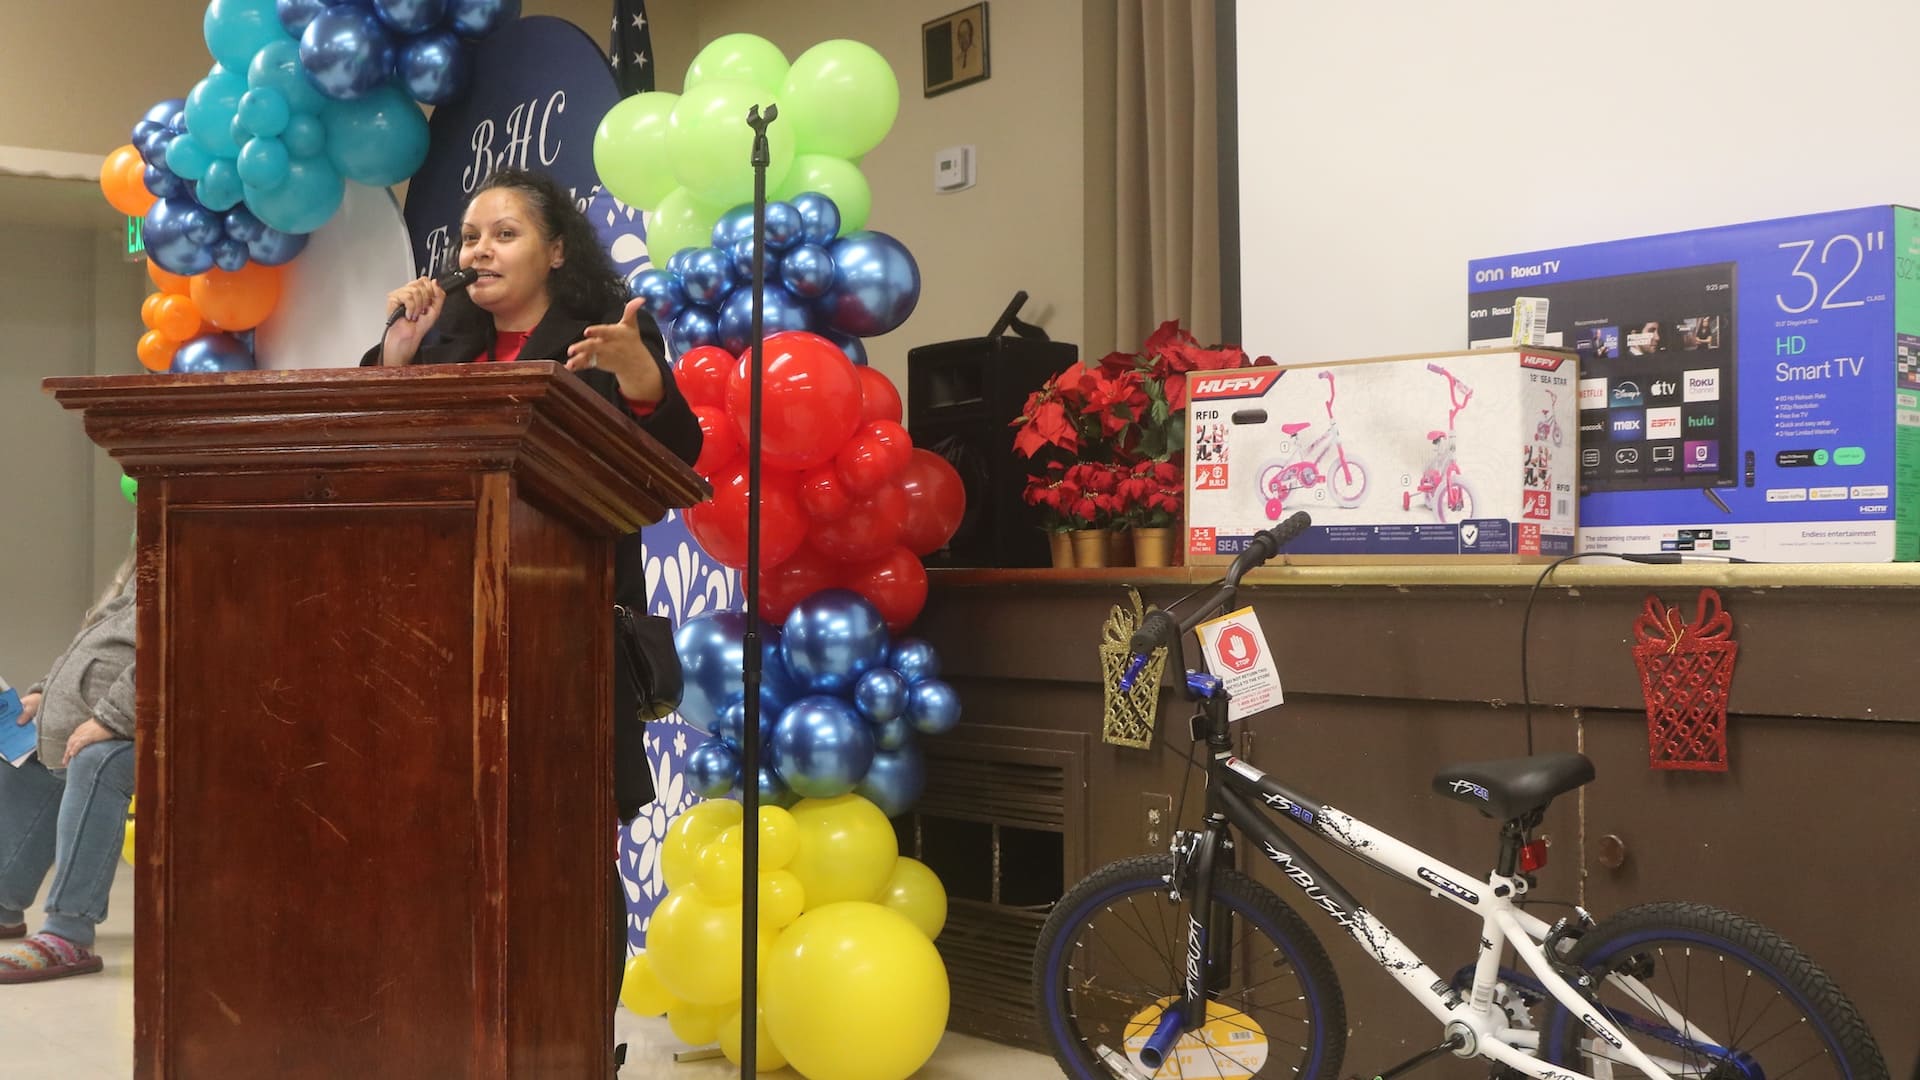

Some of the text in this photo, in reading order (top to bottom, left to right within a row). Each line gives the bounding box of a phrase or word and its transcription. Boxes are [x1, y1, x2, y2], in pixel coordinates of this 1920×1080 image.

[462, 90, 566, 193] BHC
[1475, 268, 1504, 283] onn
[1543, 260, 1560, 274] TV
[1775, 231, 1885, 314] 32"
[1470, 309, 1488, 318] onn
[1775, 335, 1806, 356] HD
[1524, 355, 1556, 367] HUFFY
[1775, 356, 1865, 382] Smart TV
[1196, 376, 1265, 393] HUFFY
[1540, 375, 1552, 384] SEA
[1552, 377, 1567, 385] STAR
[1195, 410, 1219, 420] RFID
[1688, 415, 1715, 427] hulu
[1613, 419, 1640, 431] max
[1651, 418, 1676, 428] ESPN
[1556, 484, 1570, 492] RFID
[1194, 529, 1209, 537] 3-5
[1801, 529, 1877, 538] Endless entertainment
[1218, 540, 1239, 551] SEA
[1541, 541, 1552, 549] SEA
[1596, 535, 1625, 544] streaming
[1235, 658, 1250, 667] STOP
[1242, 671, 1258, 680] RETURN
[1263, 840, 1354, 928] AMBUSH
[1421, 870, 1478, 899] KENT
[1184, 913, 1204, 1003] AMBUSH
[1584, 1015, 1622, 1046] KENT
